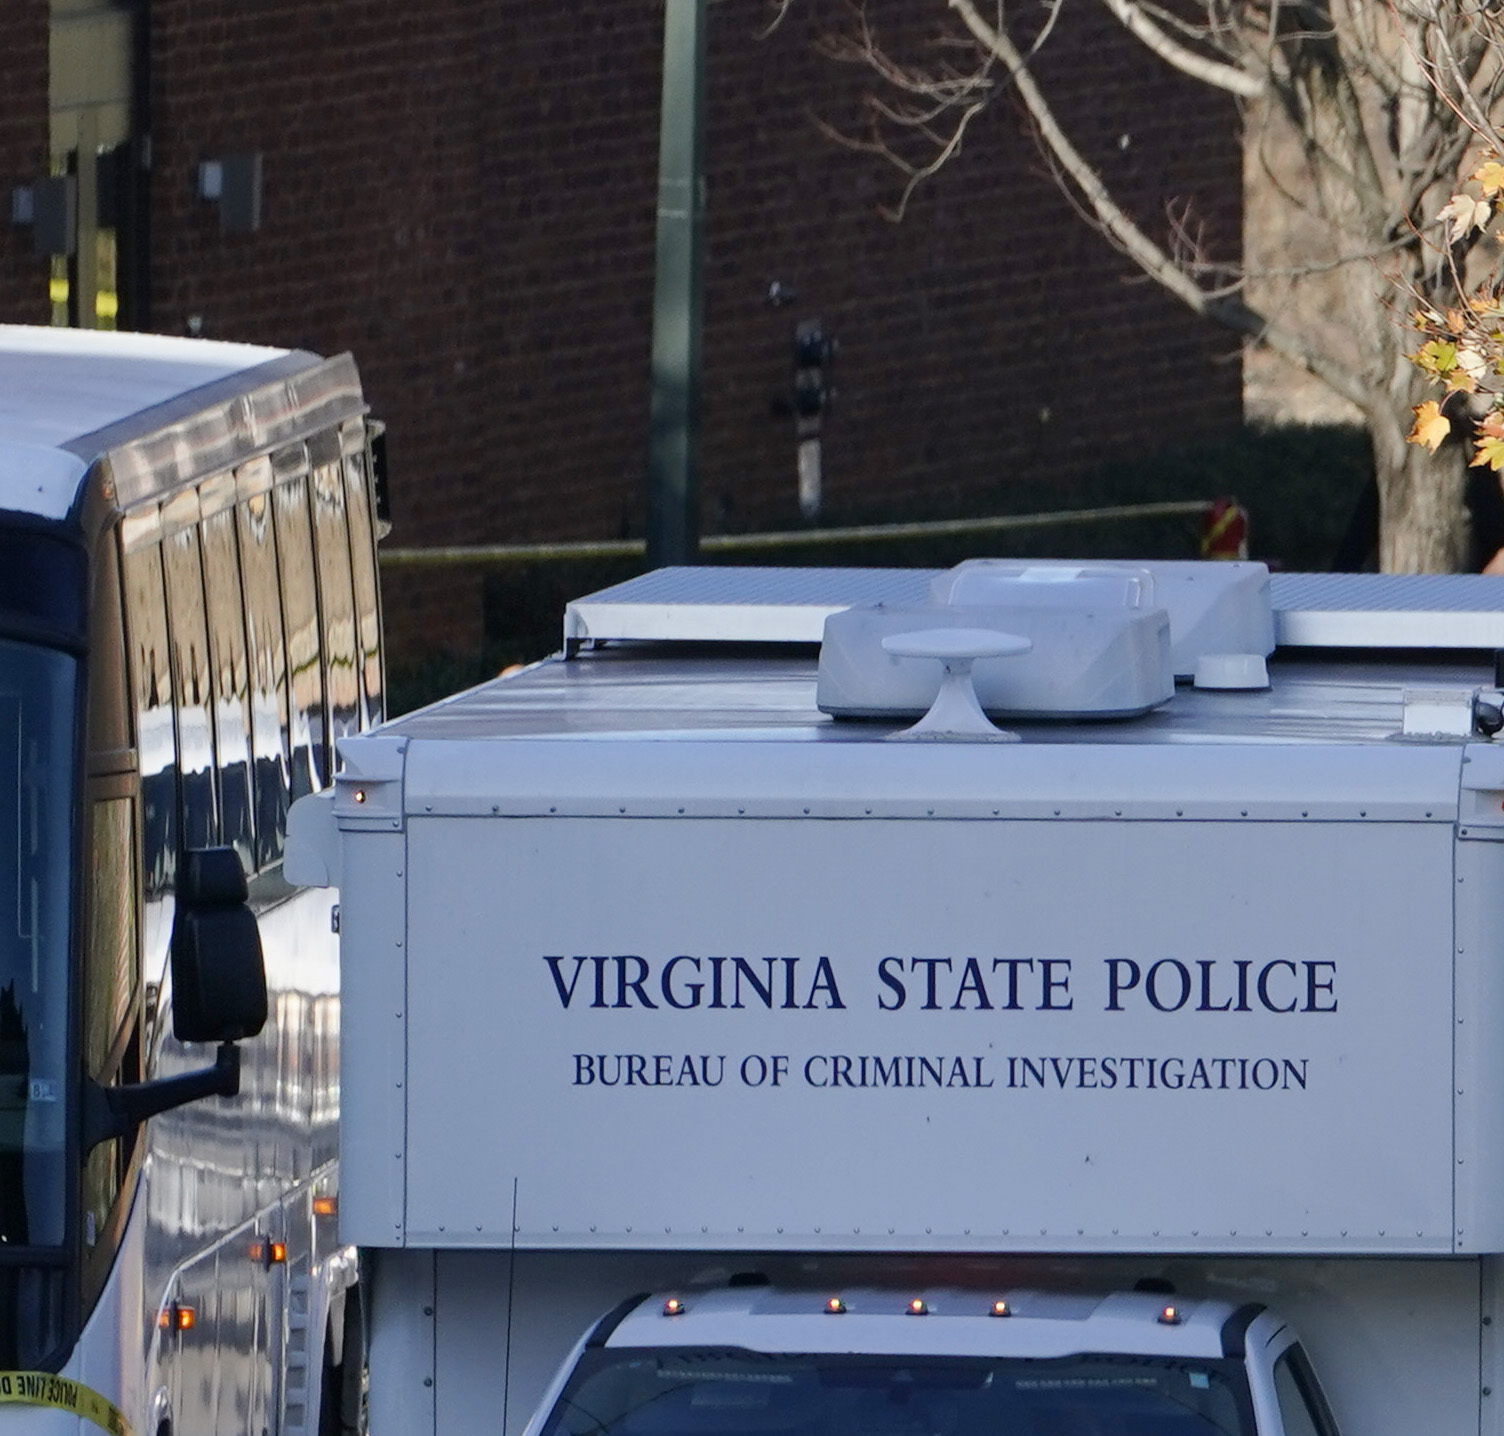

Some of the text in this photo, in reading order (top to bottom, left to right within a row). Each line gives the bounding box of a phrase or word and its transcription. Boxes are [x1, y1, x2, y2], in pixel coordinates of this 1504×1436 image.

[543, 956, 1339, 1014] VIRGINIA STATE POLICE
[572, 1053, 1309, 1091] BUREAU OF CRIMINAL INVESTIGATION
[17, 1375, 46, 1399] LINE
[47, 1377, 78, 1408] POLICE
